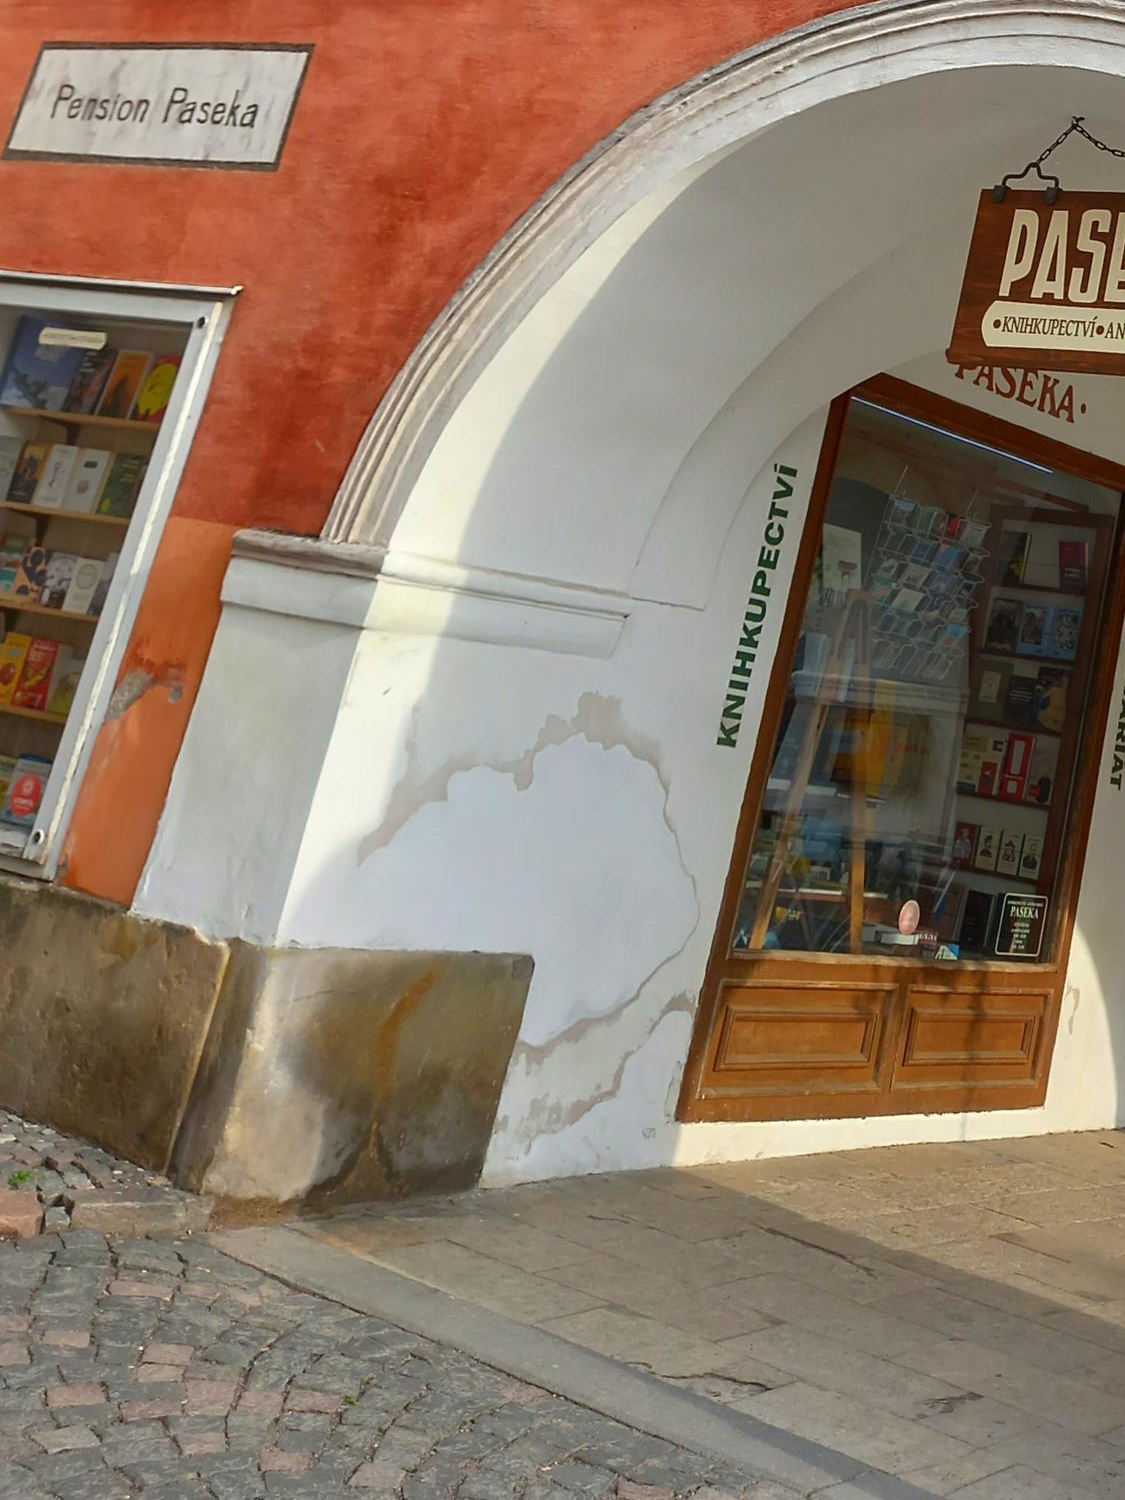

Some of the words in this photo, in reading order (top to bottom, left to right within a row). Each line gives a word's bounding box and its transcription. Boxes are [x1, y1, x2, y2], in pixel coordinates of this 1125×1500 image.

[50, 84, 150, 123] Pension
[162, 87, 259, 129] Paseka
[715, 463, 798, 748] KNIHKUPECTVÍ
[1010, 906, 1039, 919] PASEKA
